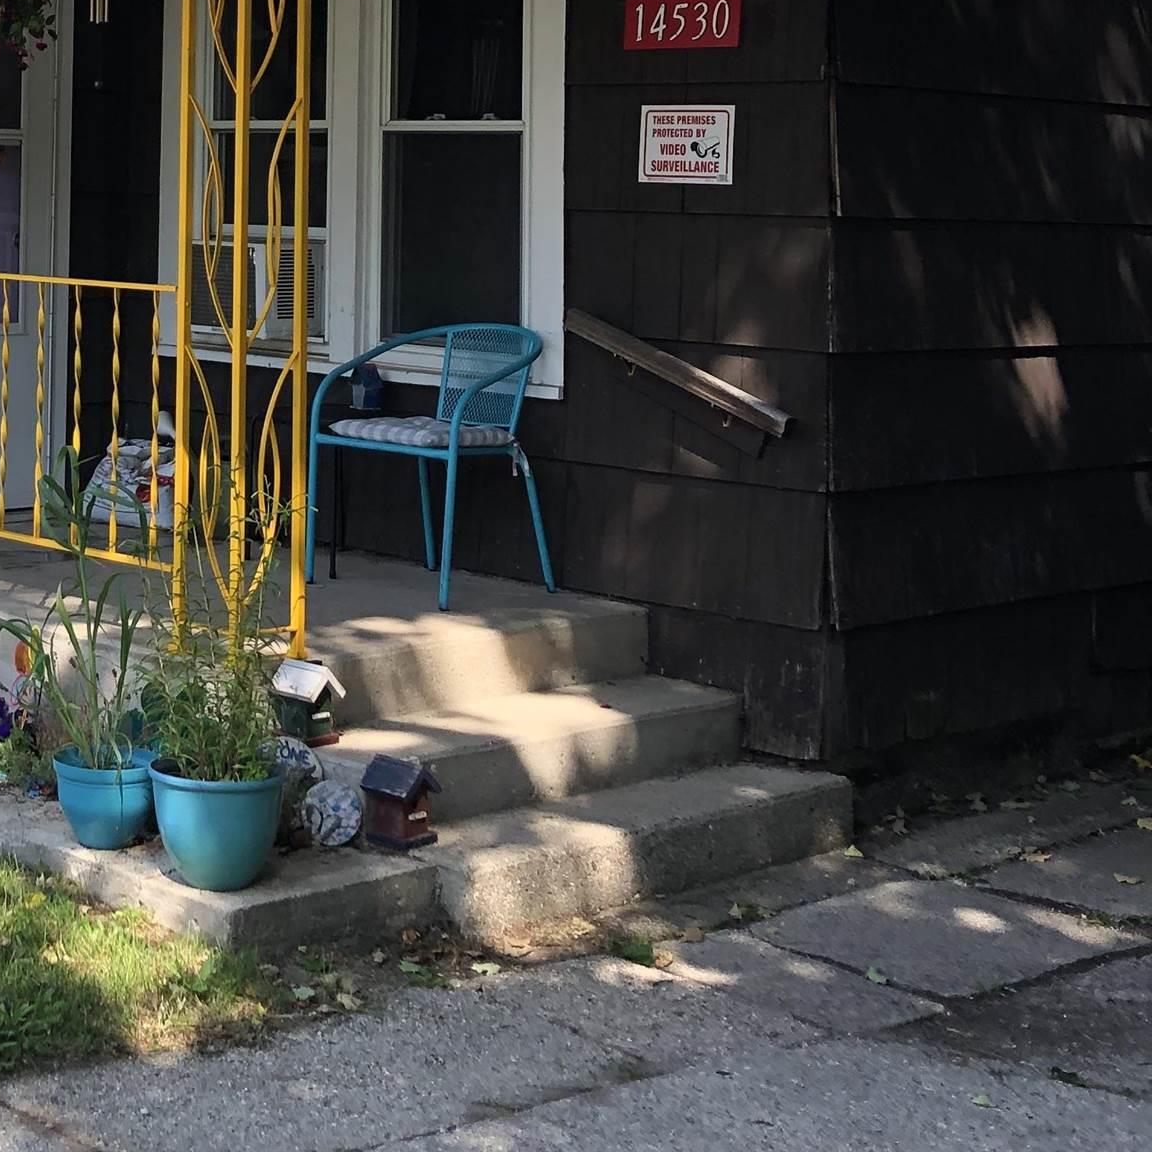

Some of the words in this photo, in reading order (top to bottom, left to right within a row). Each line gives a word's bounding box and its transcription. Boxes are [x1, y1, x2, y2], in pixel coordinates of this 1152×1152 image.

[636, 0, 729, 41] 14530
[653, 115, 675, 125] THESE
[677, 115, 716, 125] PREMISES
[652, 128, 694, 138] PROTECTED
[696, 128, 706, 138] BY
[660, 144, 686, 155] VIDEO
[651, 160, 720, 173] SURVEILLANCE
